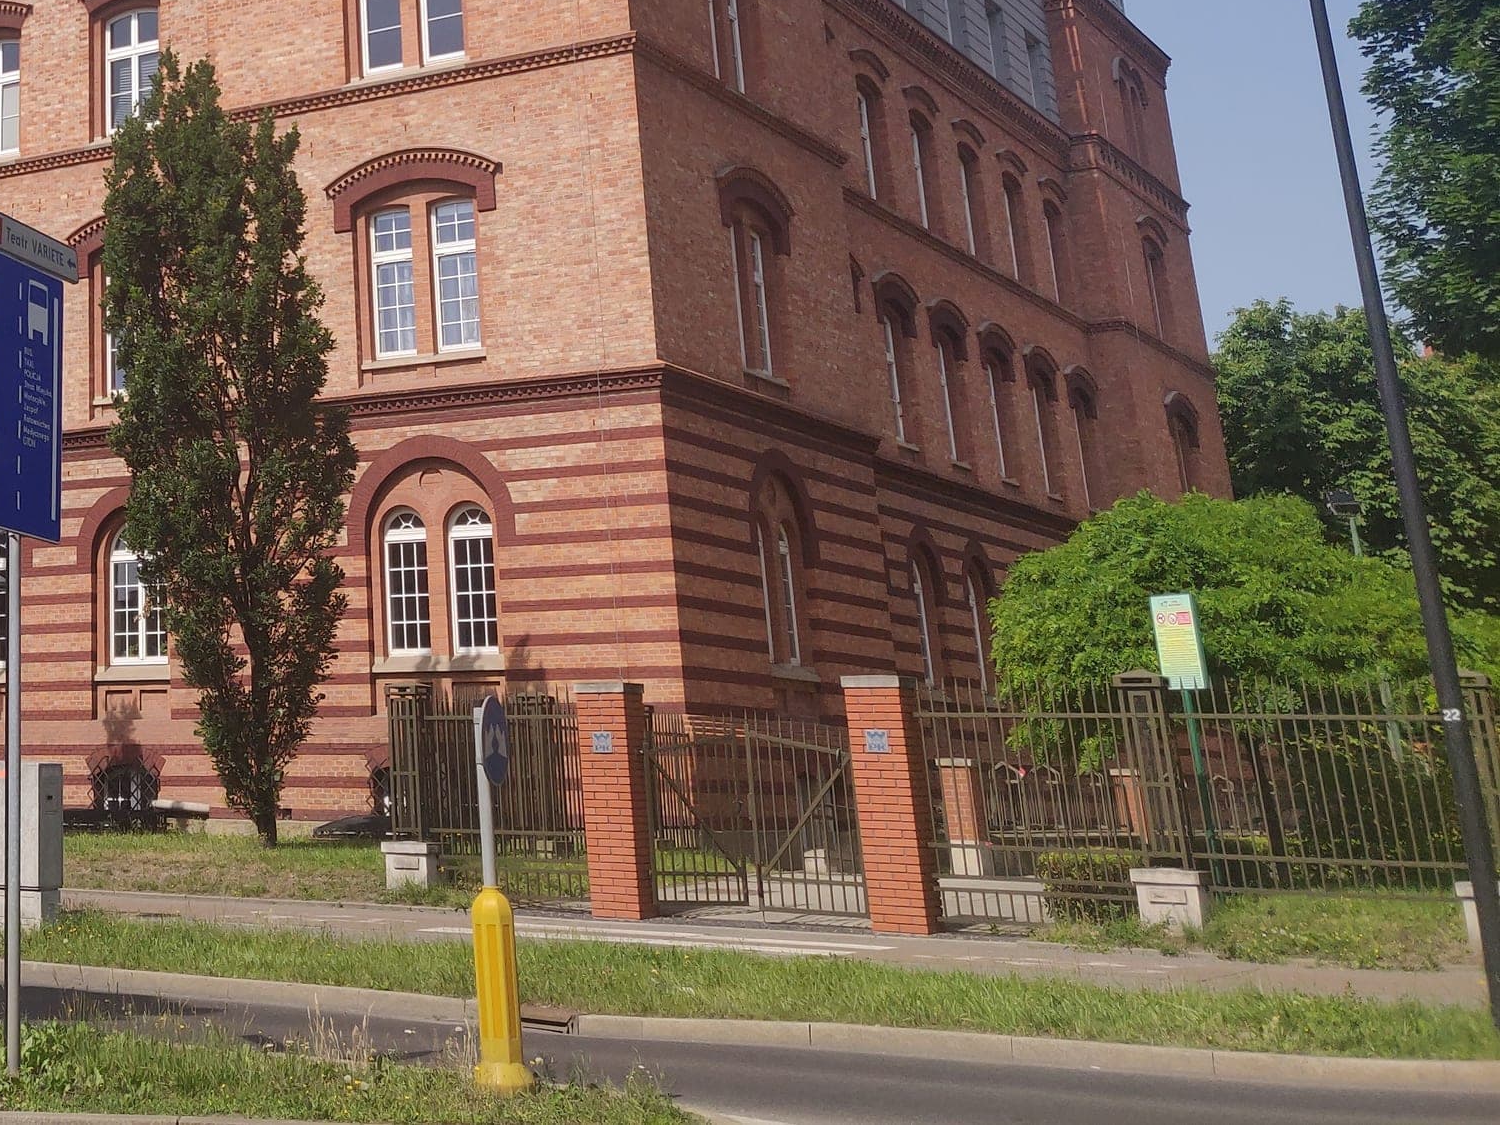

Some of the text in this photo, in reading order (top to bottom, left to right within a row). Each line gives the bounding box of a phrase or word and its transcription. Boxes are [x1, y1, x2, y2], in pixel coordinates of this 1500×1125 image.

[6, 227, 64, 266] Teatr VARIETE
[1442, 708, 1461, 722] 22
